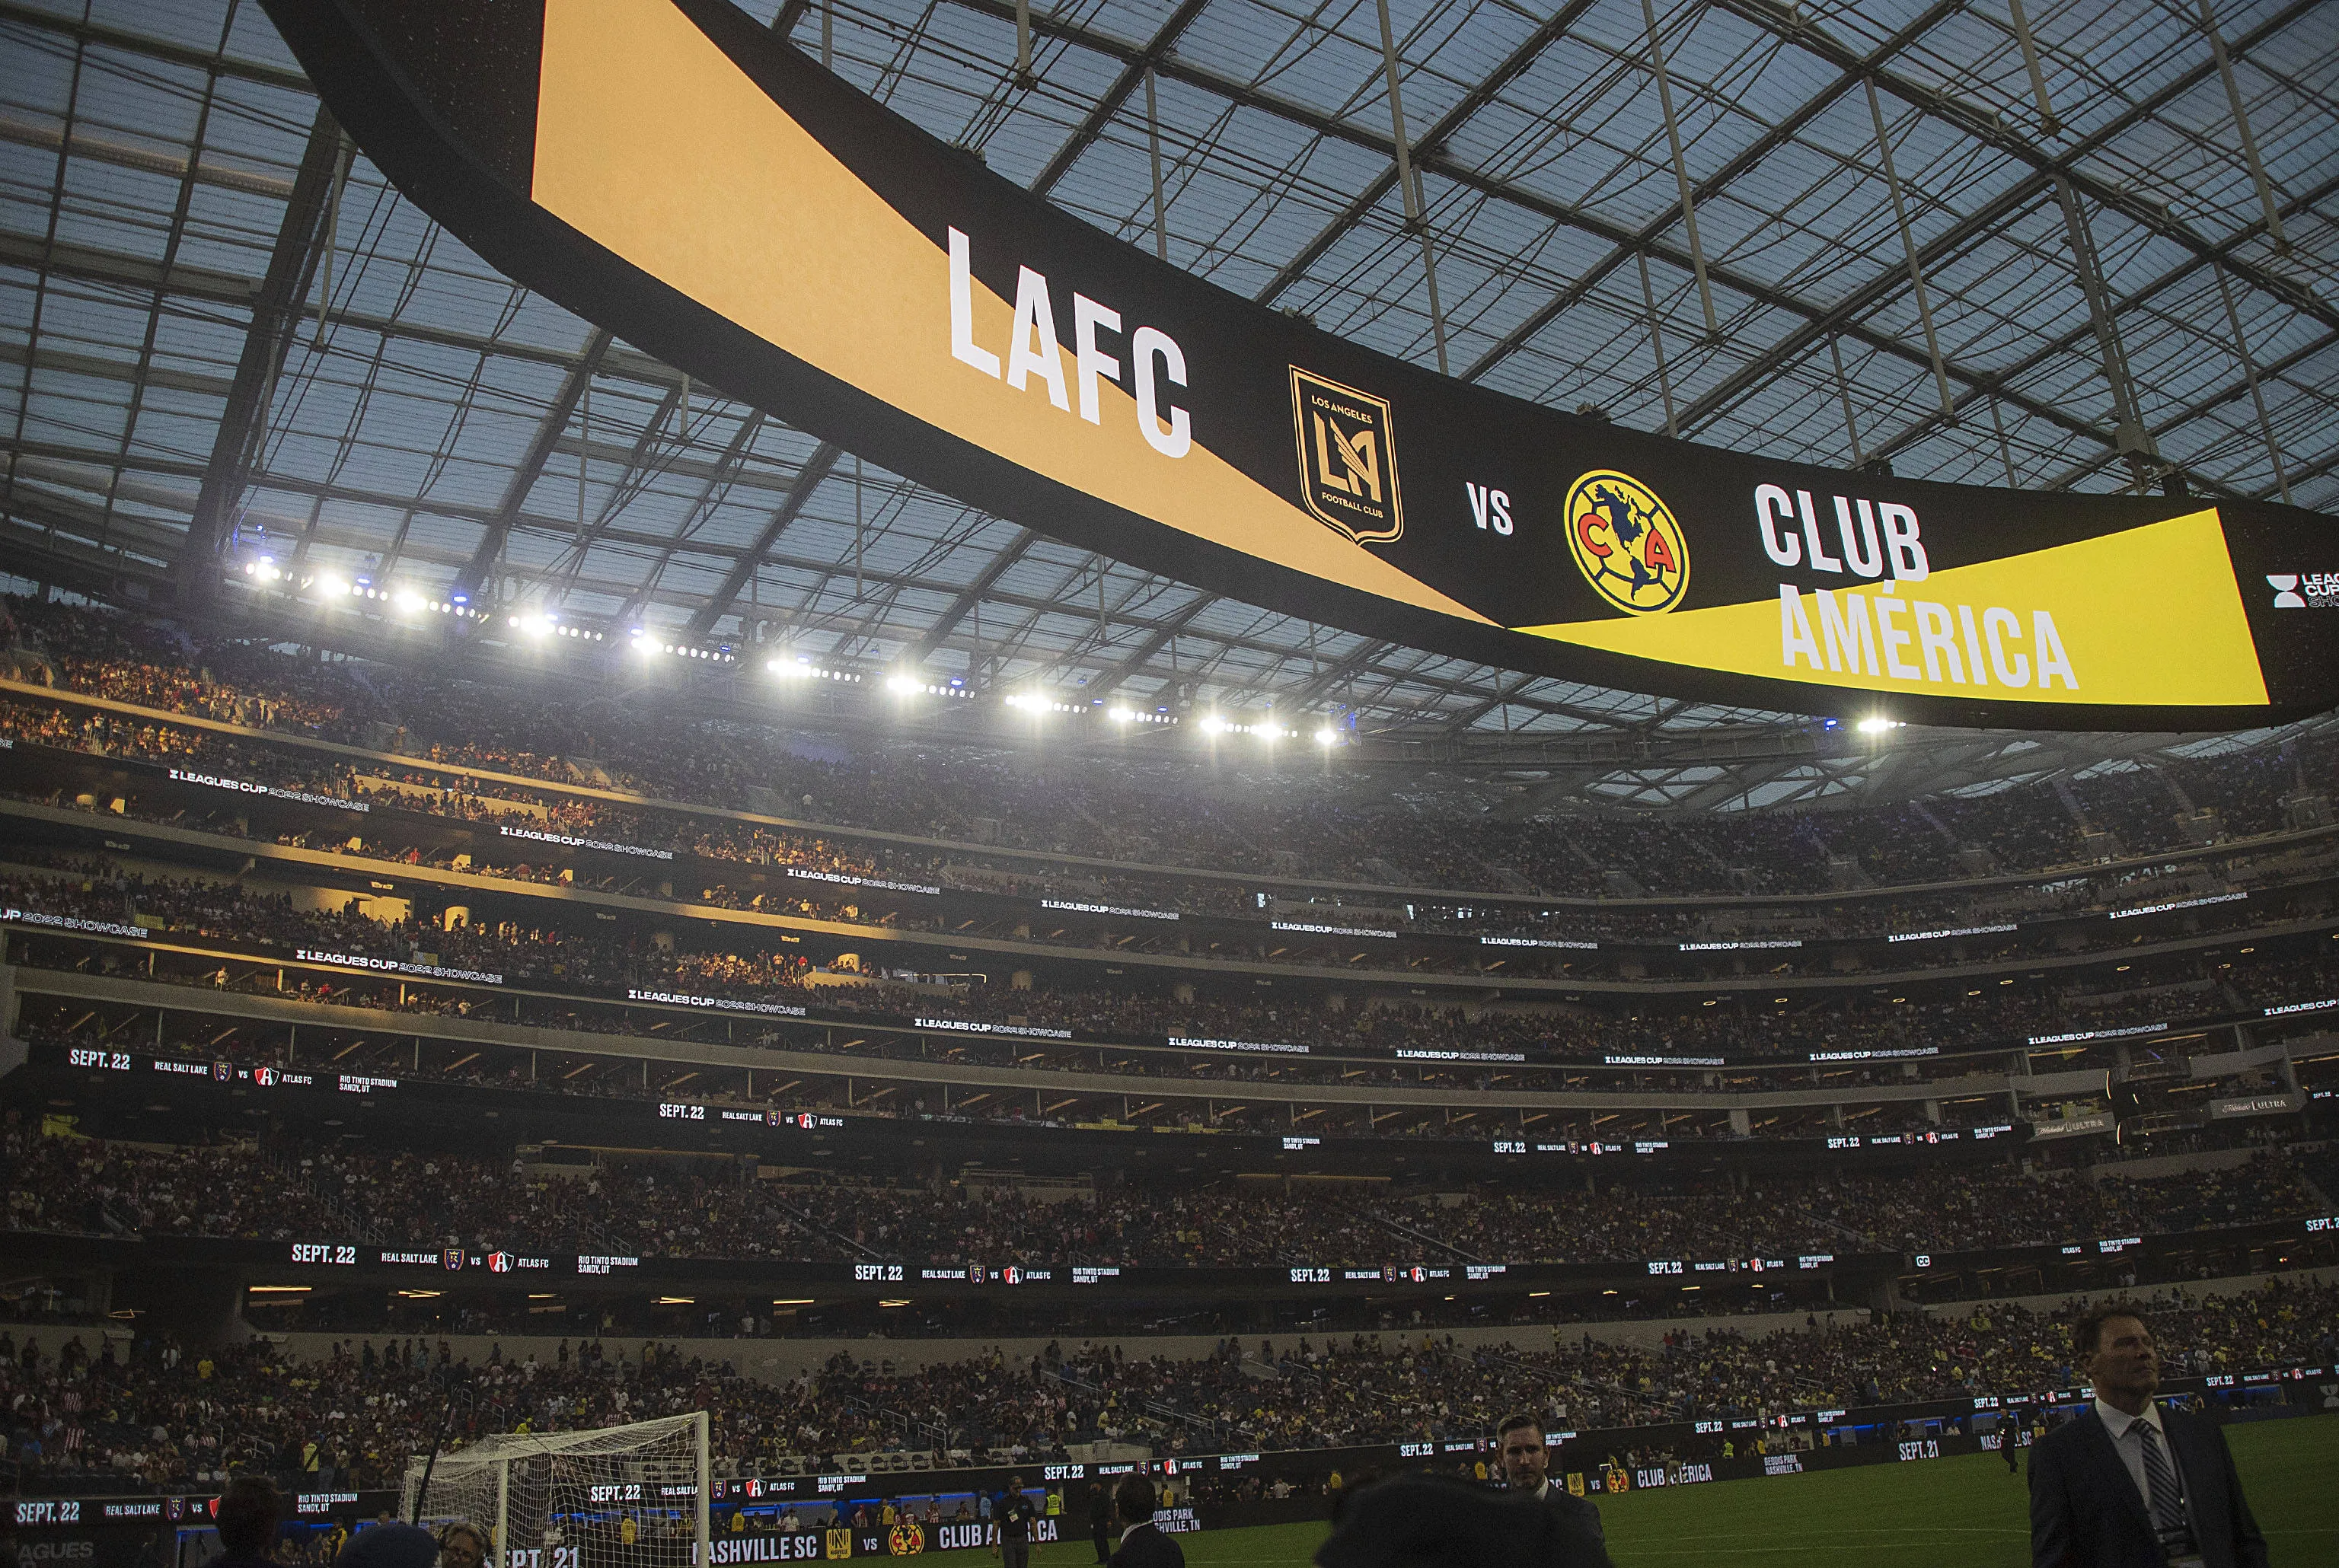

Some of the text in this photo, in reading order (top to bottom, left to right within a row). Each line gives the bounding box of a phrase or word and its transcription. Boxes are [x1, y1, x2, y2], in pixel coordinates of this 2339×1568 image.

[949, 225, 1192, 459] LAFC
[1311, 394, 1373, 424] LOS ANGELES
[1322, 492, 1383, 518] FOOTBALL CLUB
[1466, 481, 1514, 535] VS
[1754, 483, 1929, 581] CLUB
[2305, 585, 2339, 596] CUP
[1779, 579, 2079, 690] AMÉRICA
[180, 771, 369, 812] LEAGUES CUP 2022 SHOWCASE
[509, 827, 673, 860] LEAGUES CUP 2022 SHOWCASE
[795, 869, 862, 885] LEAGUES CUP
[1048, 900, 1109, 913] LEAGUES CUP
[2116, 904, 2176, 918] LEAGUES CUP
[22, 913, 63, 926] 2022
[64, 917, 148, 939] SHOWCASE
[1278, 923, 1332, 934] LEAGUES CUP
[1487, 937, 1521, 946] LEAGUES
[1894, 932, 1932, 942] LEAGUES
[307, 950, 503, 983] LEAGUES CUP 2022 SHOWCASE
[637, 990, 806, 1015] LEAGUES CUP 2022 SHOWCASE
[2272, 999, 2337, 1015] LEAGUES CUP
[923, 1018, 991, 1032] LEAGUES CUP
[1176, 1038, 1237, 1050] LEAGUES CUP
[2035, 1033, 2076, 1044] LEAGUES
[1403, 1050, 1441, 1059] LEAGUES
[1816, 1052, 1853, 1060] LEAGUES
[70, 1049, 311, 1085] SEPT. 22 REAL SALT LAKE VS ATLAS FC
[340, 1075, 397, 1088] RIO TINTO STADIUM
[340, 1083, 370, 1093] SANDY, UT
[659, 1104, 688, 1118] SEPT.
[691, 1105, 704, 1120] 22
[1494, 1142, 1526, 1153] SEPT. 22
[1828, 1136, 1860, 1149] SEPT. 22
[2306, 1218, 2334, 1232] SEPT.
[292, 1244, 549, 1268] SEPT. 22 REAL SALT LAKE VS ATLAS FC
[578, 1256, 638, 1266] RIO TINTO STADIUM
[578, 1264, 611, 1274] SANDY, UT
[855, 1265, 1043, 1281] SEPT. 22 REAL SALT LAKE VS ATLAS
[1648, 1261, 1683, 1274] SEPT. 22
[1291, 1269, 1330, 1283] SEPT. 22
[2206, 1376, 2225, 1386] SEPT.
[2225, 1375, 2234, 1385] 22
[1695, 1422, 1713, 1433] SEPT.
[1713, 1421, 1723, 1432] 22
[1400, 1443, 1434, 1456] SEPT. 22
[1898, 1439, 1939, 1461] SEPT. 21
[1045, 1464, 1084, 1480] SEPT. 22
[1637, 1468, 1666, 1488] CLUB
[1591, 1480, 1601, 1490] VS
[298, 1493, 358, 1503] RIO TINTO STADIUM
[591, 1486, 623, 1502] SEPT.
[625, 1484, 640, 1499] 22
[17, 1501, 203, 1523] SEPT. 22 REAL SALT LAKE VS
[298, 1503, 330, 1514] SANDY, UT
[1153, 1508, 1193, 1522] ODIS PARK
[1190, 1519, 1200, 1531] TN
[939, 1524, 981, 1549] CLUB
[794, 1535, 817, 1559] SC
[863, 1538, 878, 1550] VS
